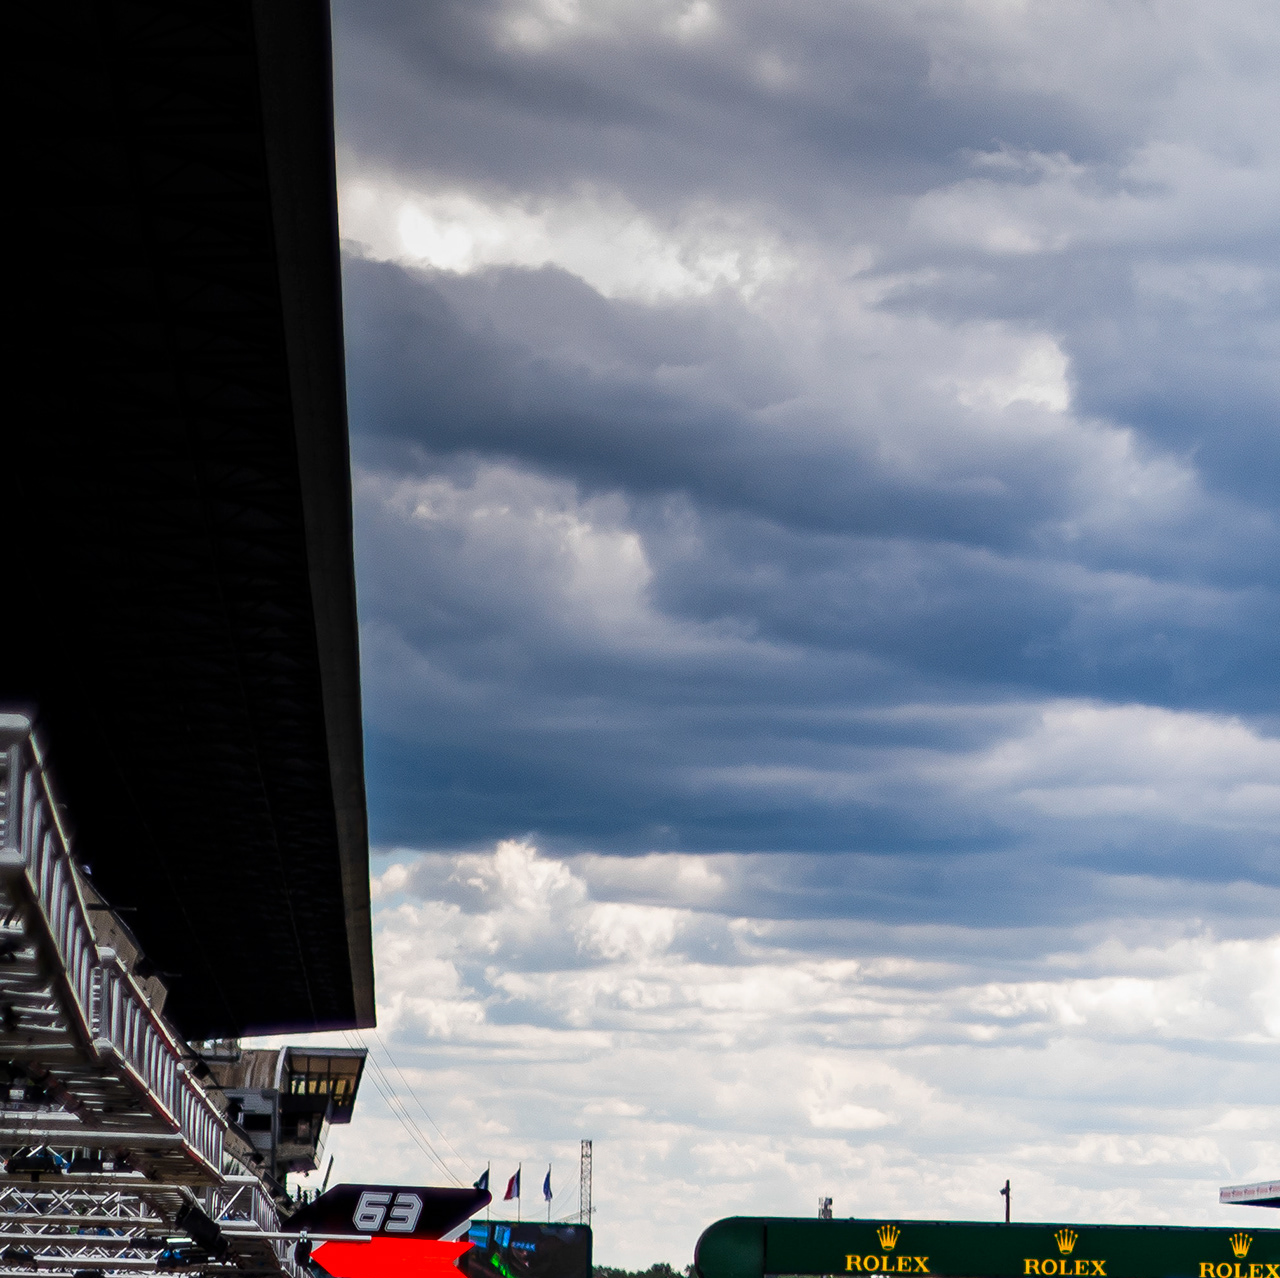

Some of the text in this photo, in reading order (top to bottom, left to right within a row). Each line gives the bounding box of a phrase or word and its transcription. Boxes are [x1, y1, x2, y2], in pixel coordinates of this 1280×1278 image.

[352, 1190, 423, 1232] 63
[845, 1254, 930, 1273] ROLEX
[1023, 1258, 1107, 1276] ROLEX
